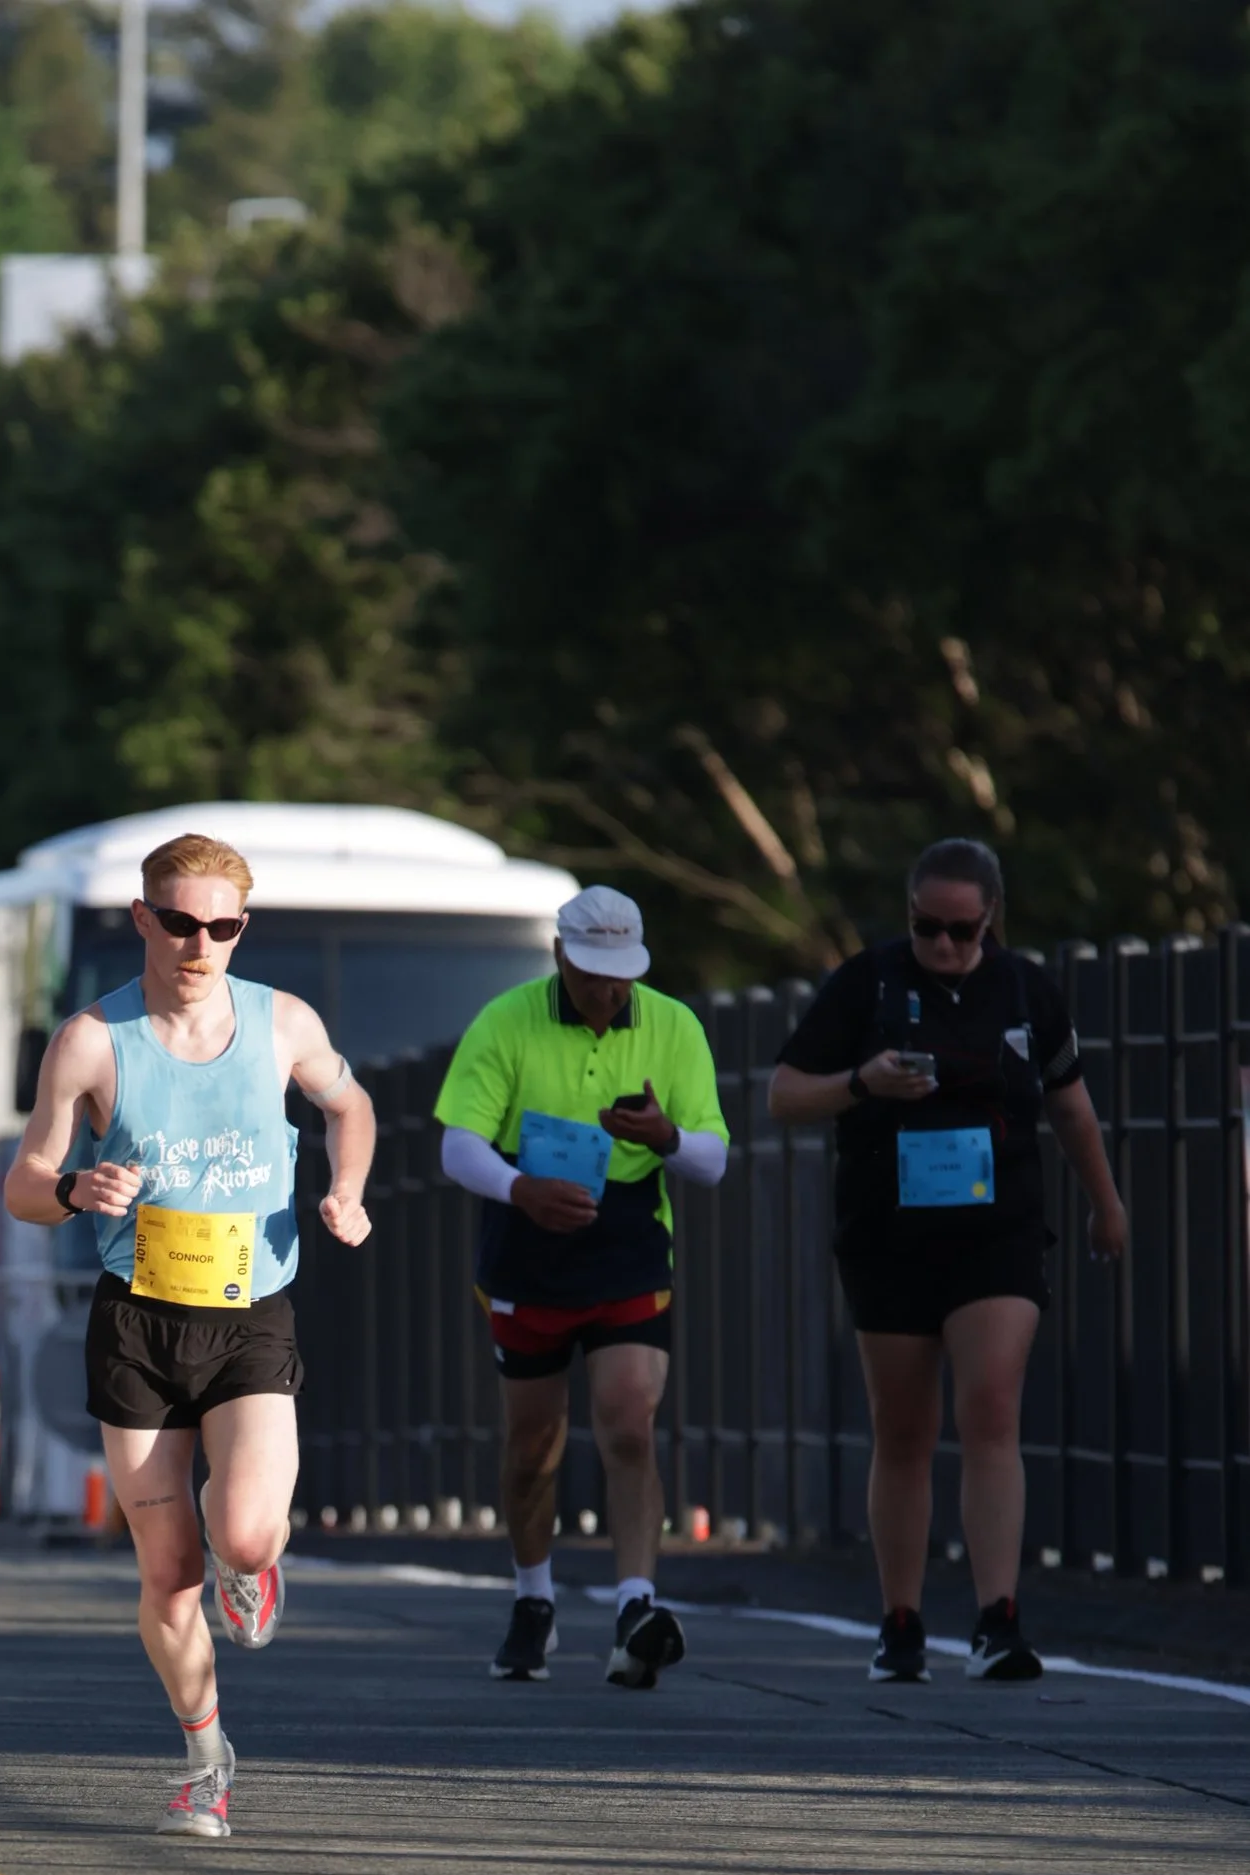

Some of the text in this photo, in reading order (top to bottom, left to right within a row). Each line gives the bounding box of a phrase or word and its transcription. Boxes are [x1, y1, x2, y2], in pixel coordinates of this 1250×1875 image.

[136, 1234, 147, 1264] 4010
[168, 1251, 214, 1264] CONNOR
[237, 1245, 249, 1275] 4010
